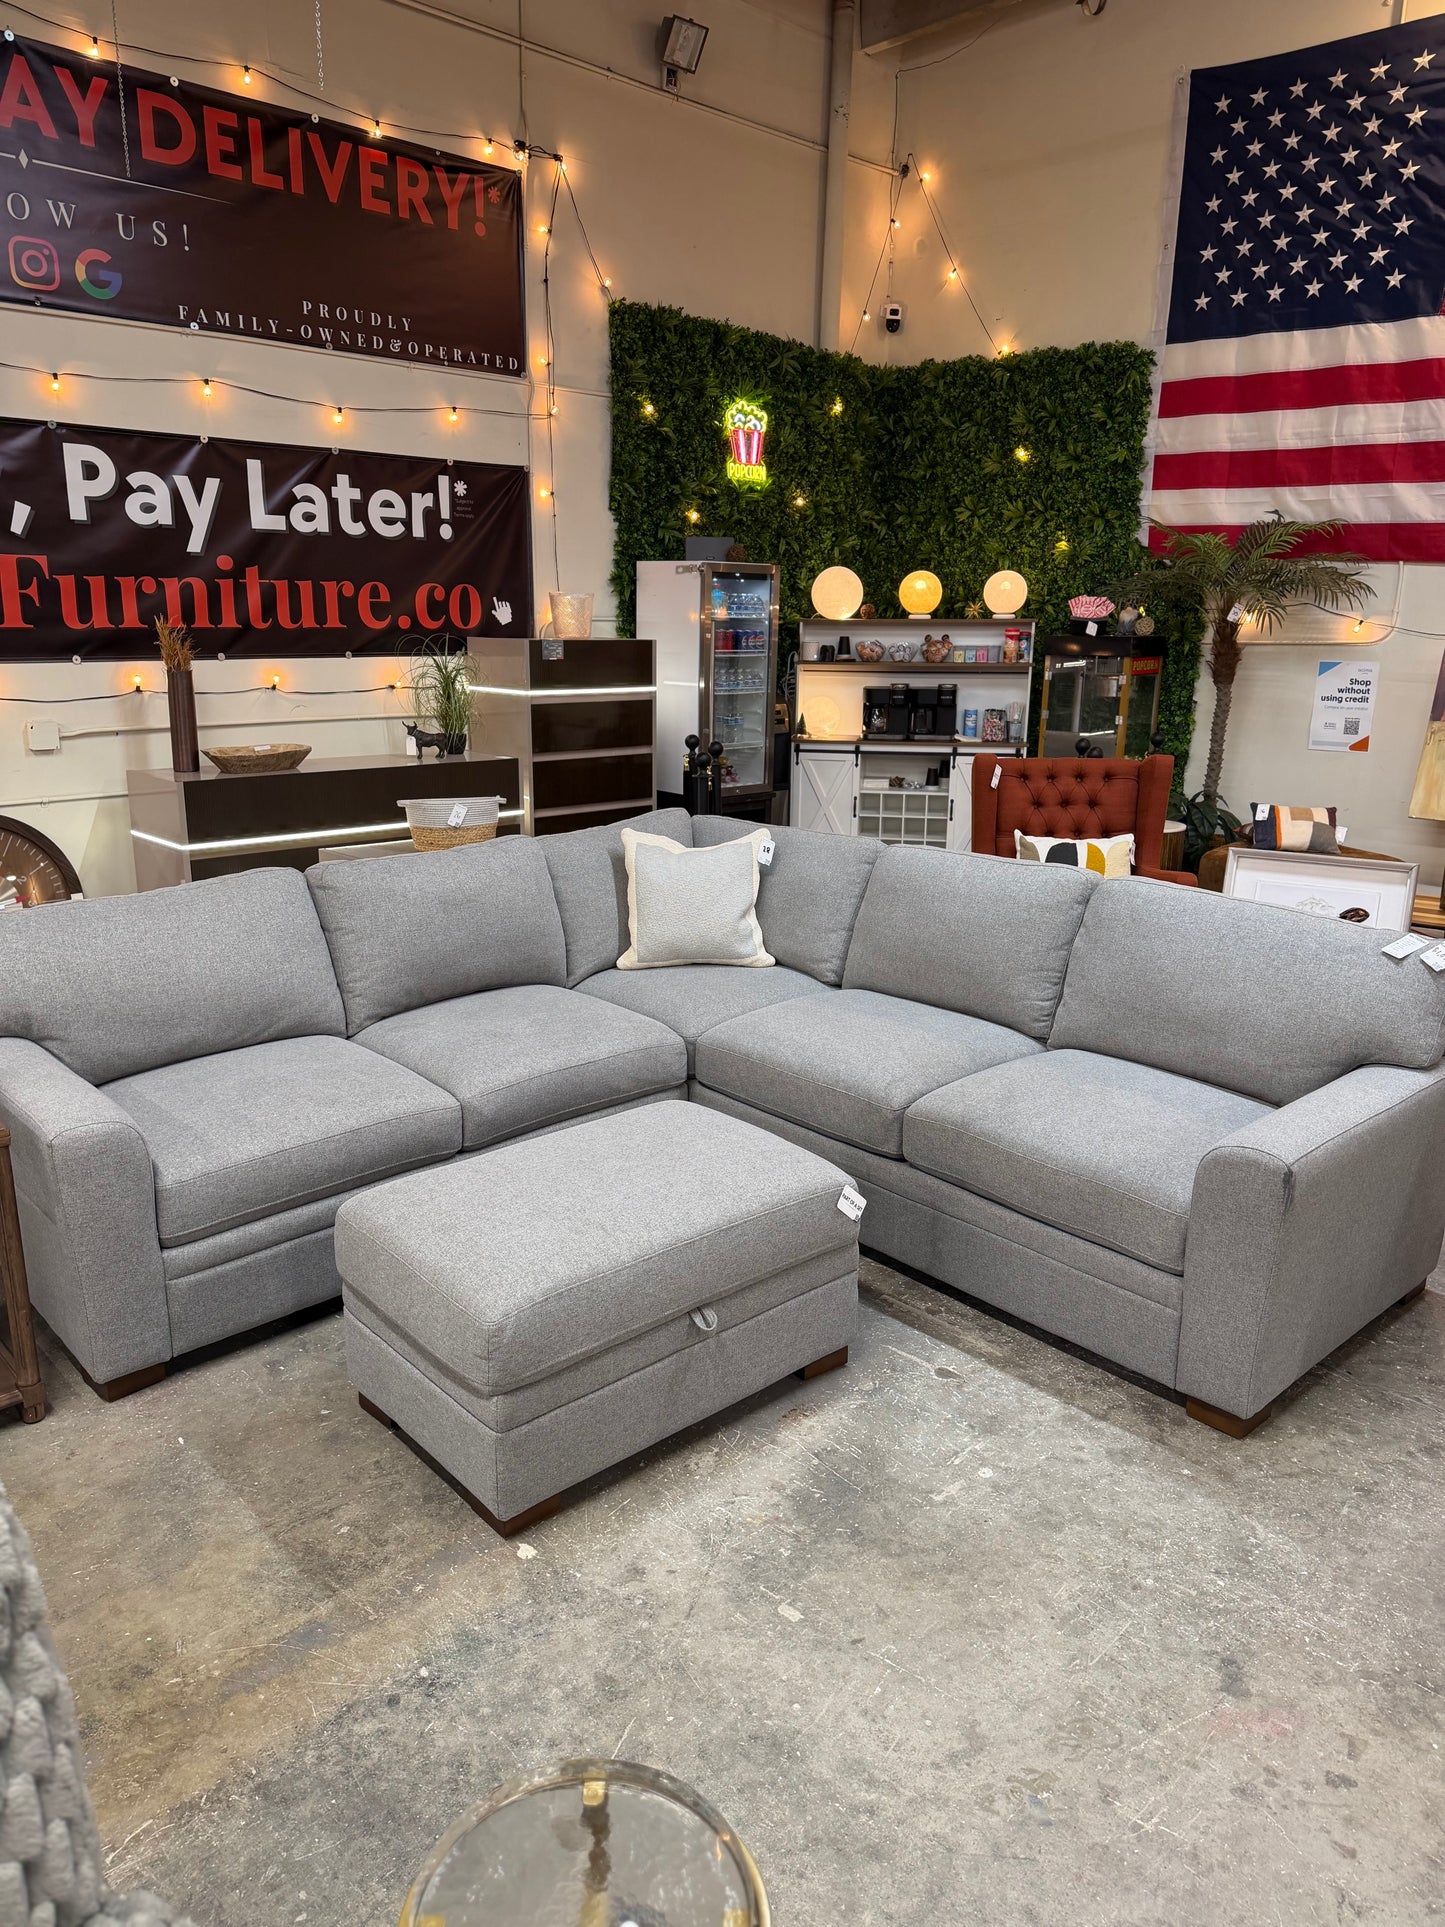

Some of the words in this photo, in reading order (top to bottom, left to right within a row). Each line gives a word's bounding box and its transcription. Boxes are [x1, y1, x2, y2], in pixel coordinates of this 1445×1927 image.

[0, 54, 109, 148] AY
[6, 192, 77, 229] OW
[115, 212, 190, 252] US!
[302, 300, 411, 332] PROUDLY
[728, 462, 767, 481] POPCORN
[62, 441, 223, 556] Pay
[0, 553, 482, 631] Furniture.co
[1337, 686, 1370, 695] without
[1349, 677, 1371, 687] Shop
[1321, 694, 1343, 703] using
[1345, 695, 1369, 703] credit
[17, 875, 27, 885] 2
